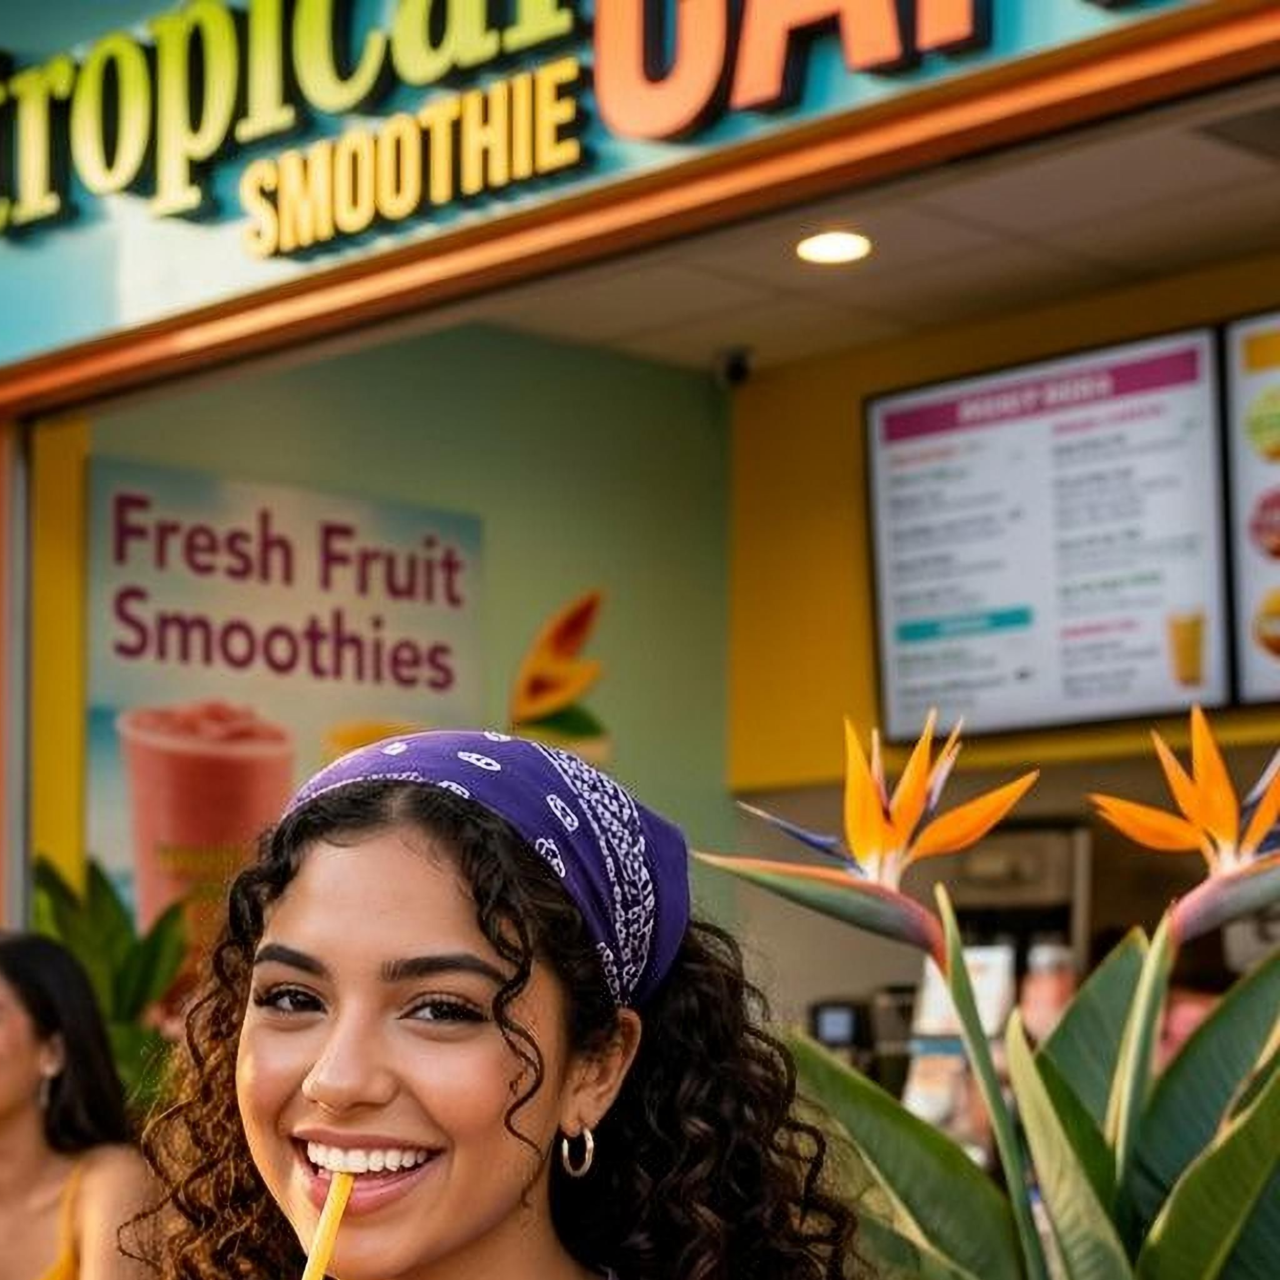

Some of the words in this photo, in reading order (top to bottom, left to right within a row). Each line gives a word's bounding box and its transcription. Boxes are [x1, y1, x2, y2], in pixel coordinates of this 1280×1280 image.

[240, 56, 580, 257] SMOOTHIE
[111, 493, 294, 588] Fresh
[319, 520, 463, 609] Fruit
[112, 587, 455, 692] Smoothies
